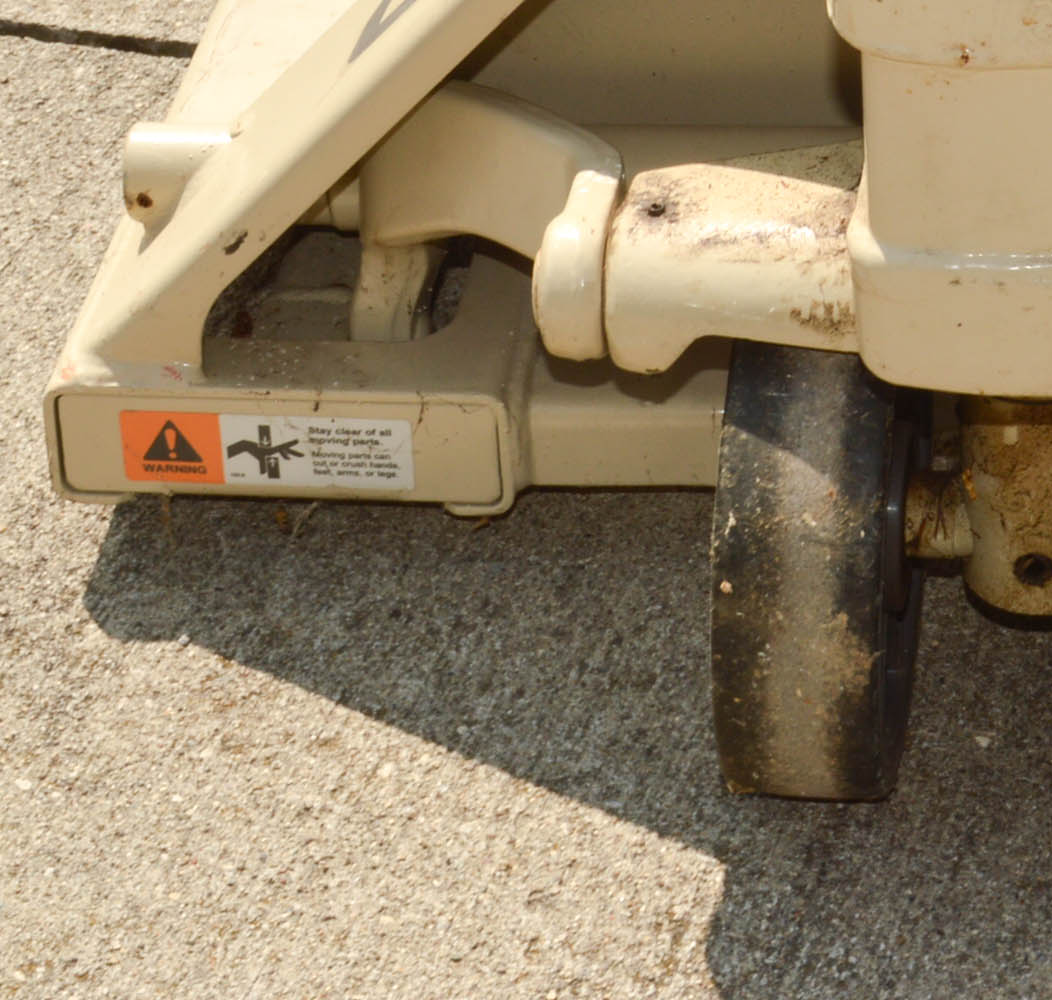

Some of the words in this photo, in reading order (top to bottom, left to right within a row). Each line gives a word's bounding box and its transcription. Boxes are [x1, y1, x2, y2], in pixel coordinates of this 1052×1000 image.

[308, 427, 331, 436] Stay
[309, 438, 349, 446] moving
[312, 451, 345, 459] Moving
[143, 463, 207, 474] WARNING
